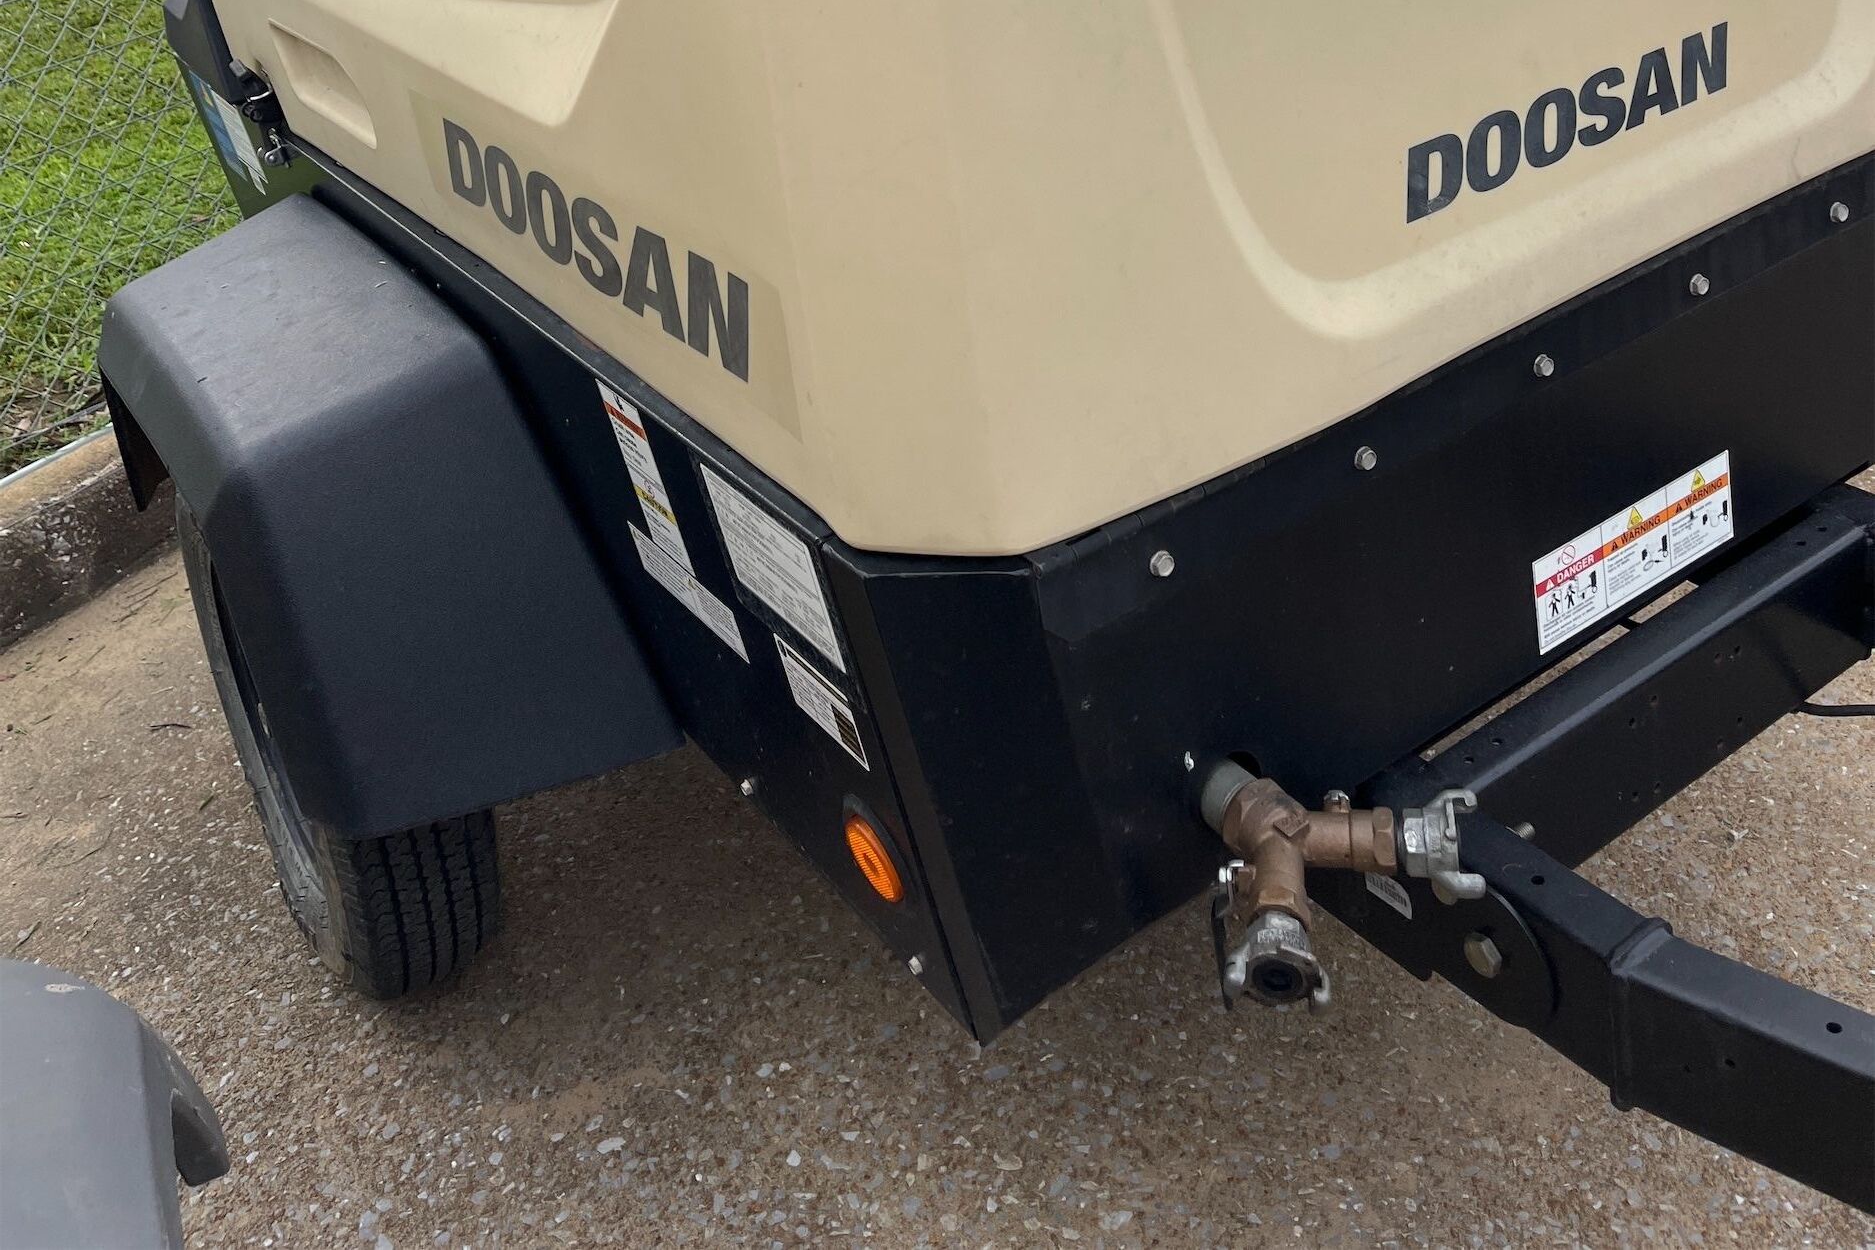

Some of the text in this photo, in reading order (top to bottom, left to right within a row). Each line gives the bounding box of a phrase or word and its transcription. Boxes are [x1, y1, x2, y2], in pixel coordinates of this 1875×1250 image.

[1406, 21, 1728, 224] DOOSAN
[443, 117, 749, 384] DOOSAN
[1684, 477, 1723, 507] WARNING
[1620, 514, 1661, 545] WARNING
[1556, 553, 1595, 584] DANGER
